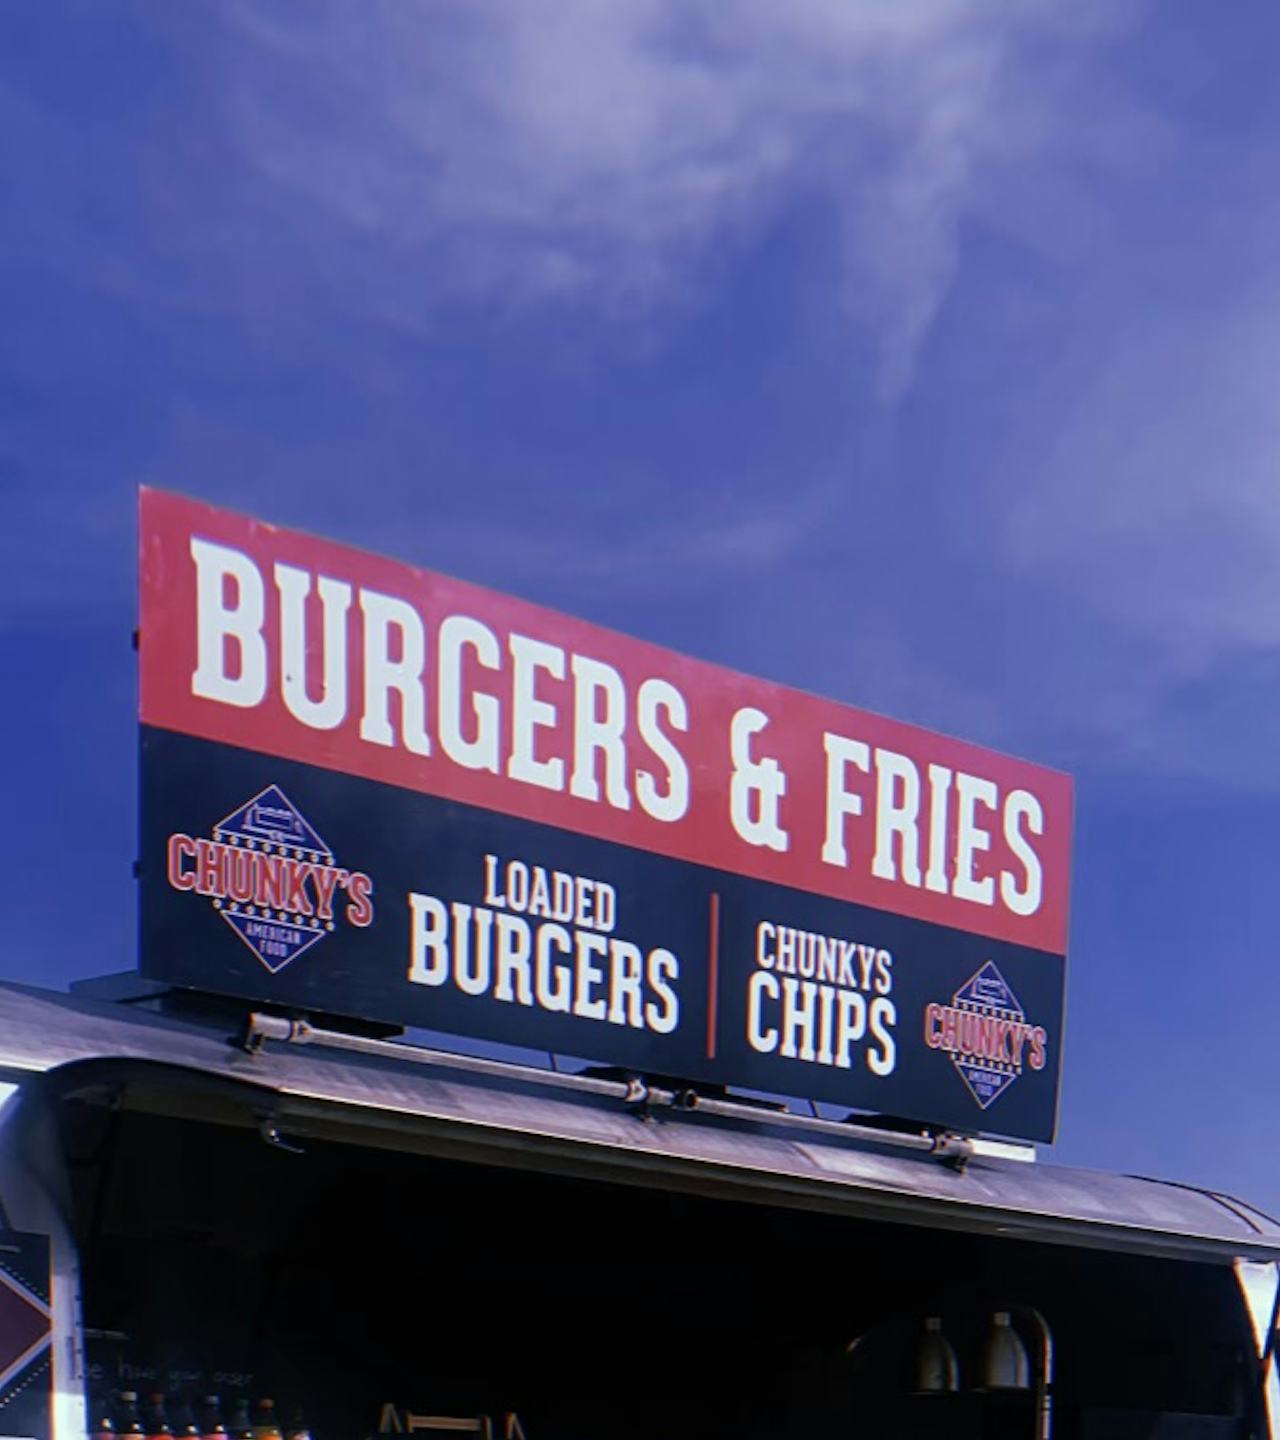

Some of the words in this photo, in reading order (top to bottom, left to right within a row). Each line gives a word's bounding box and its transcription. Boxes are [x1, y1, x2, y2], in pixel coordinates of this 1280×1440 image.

[190, 536, 688, 822] BURGERS
[730, 707, 788, 853] &
[821, 731, 1045, 916] FRIES
[167, 832, 373, 927] CHUNKY'S
[485, 854, 617, 935] LOADED
[245, 922, 301, 944] AMERICAN
[259, 940, 288, 957] FOOD
[408, 893, 679, 1036] BURGERS
[757, 920, 892, 994] CHUNKYS
[748, 972, 896, 1077] CHIPS
[924, 1002, 1047, 1070] CHUNKY'S
